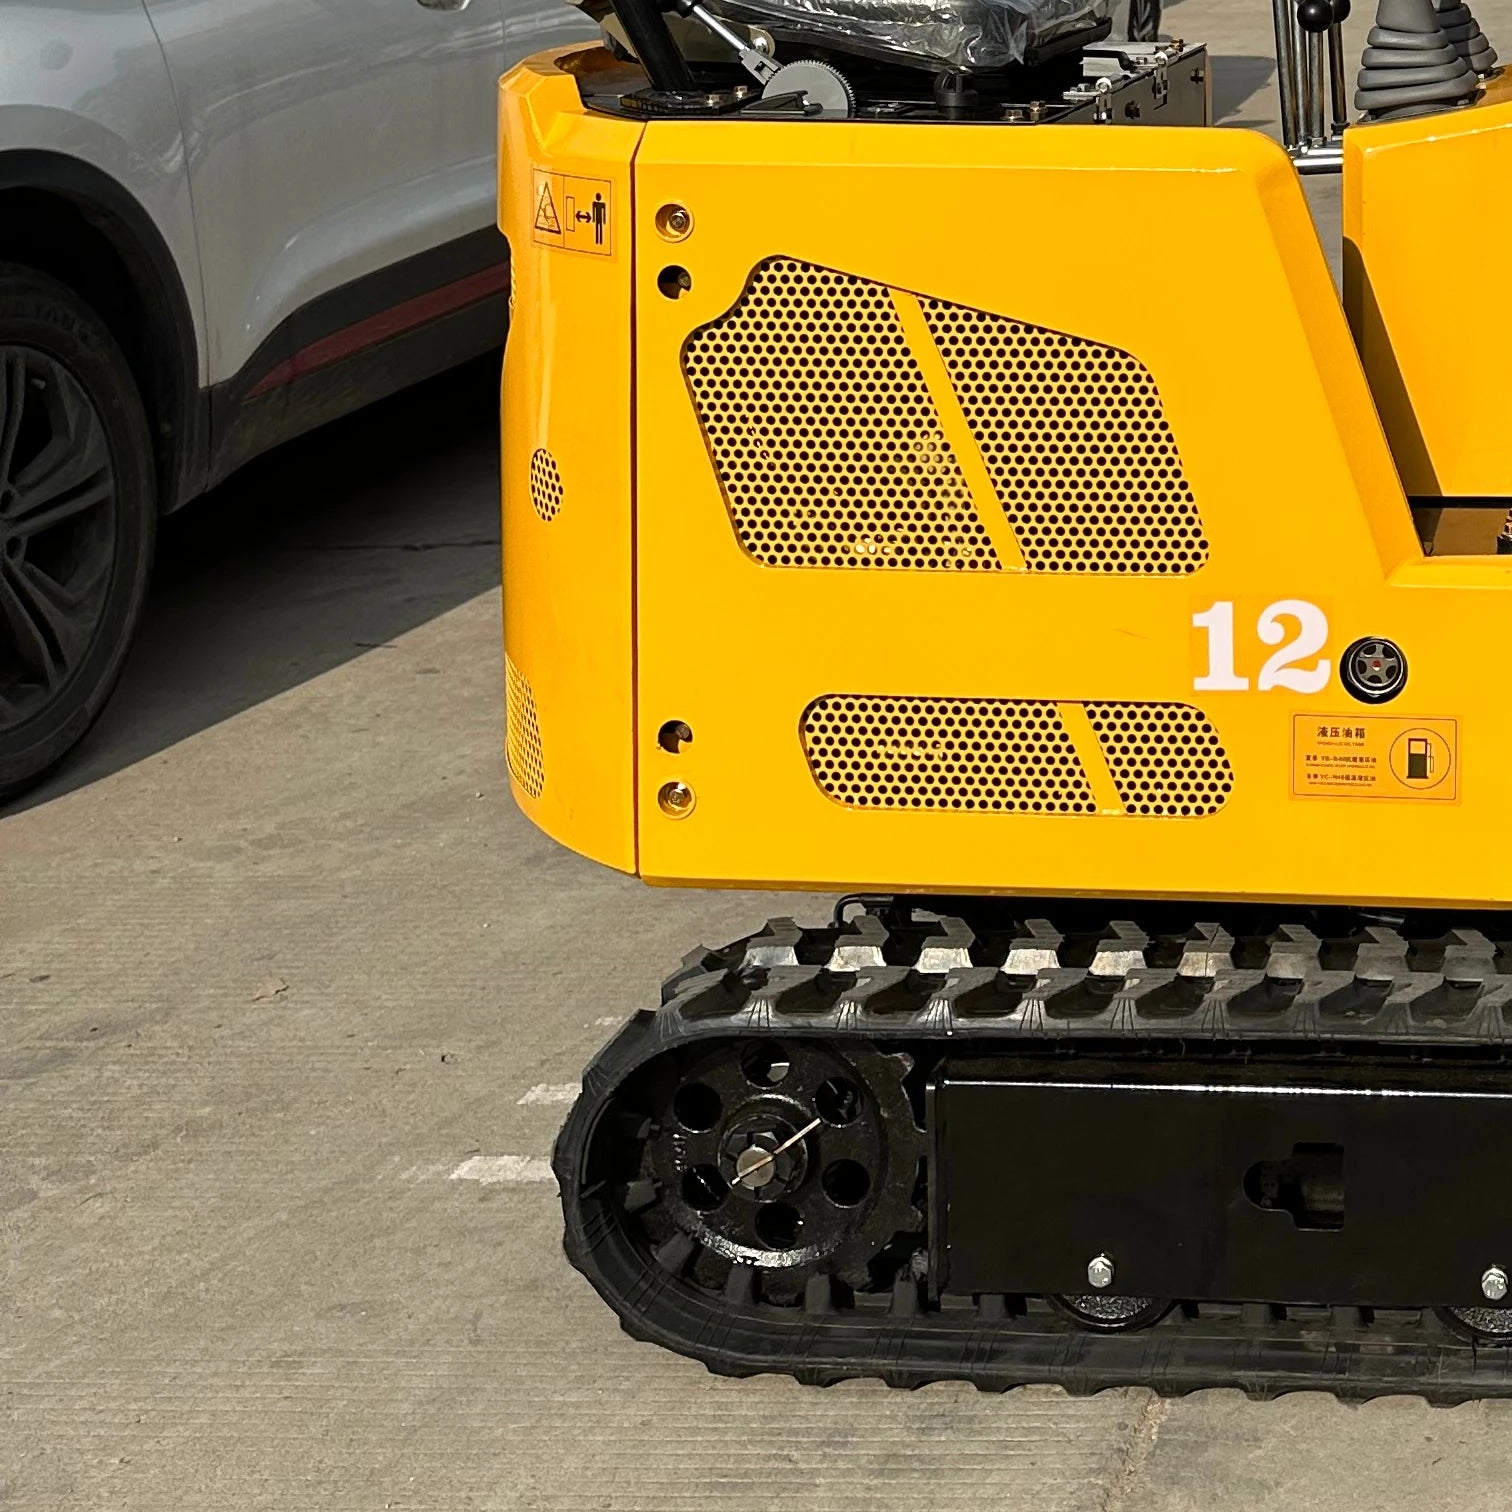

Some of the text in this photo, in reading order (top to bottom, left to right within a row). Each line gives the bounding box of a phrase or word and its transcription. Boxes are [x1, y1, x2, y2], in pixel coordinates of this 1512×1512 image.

[1192, 599, 1331, 694] 12
[1316, 726, 1366, 739] 液压油箱
